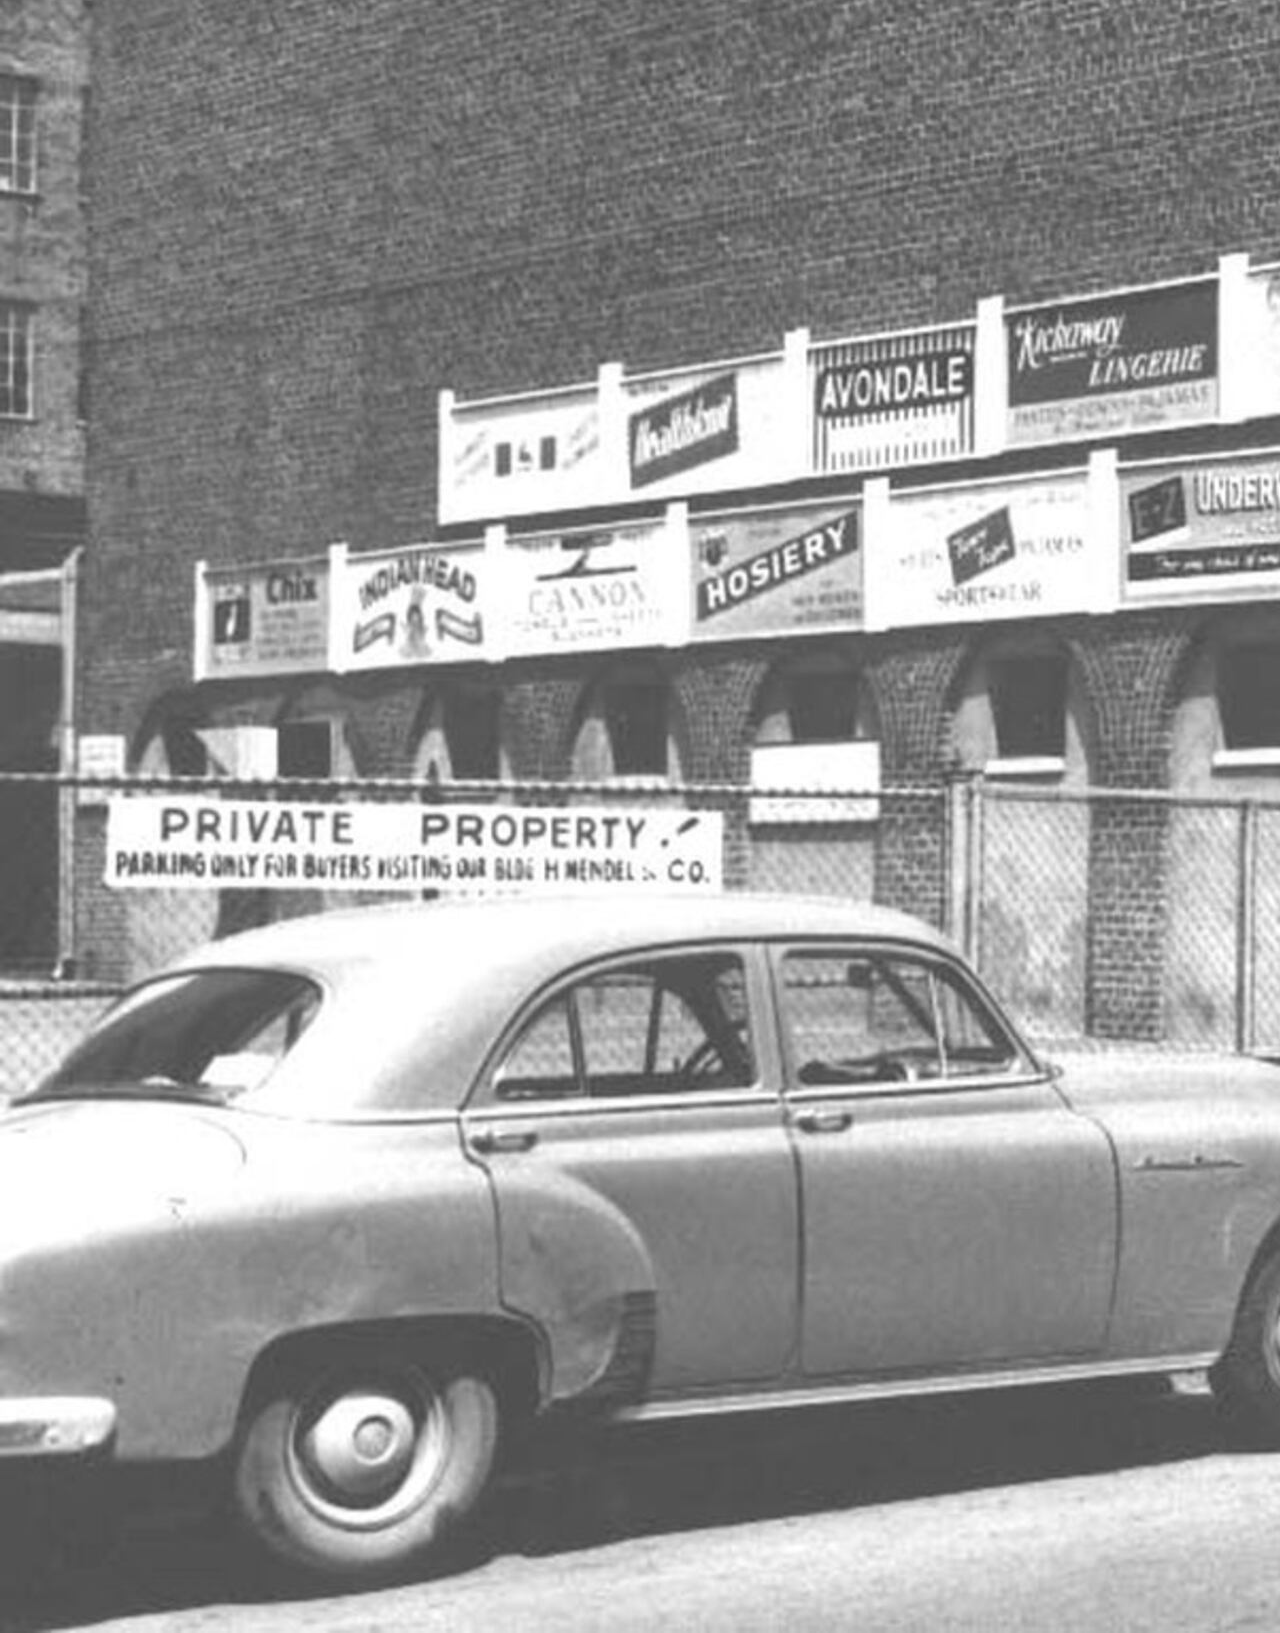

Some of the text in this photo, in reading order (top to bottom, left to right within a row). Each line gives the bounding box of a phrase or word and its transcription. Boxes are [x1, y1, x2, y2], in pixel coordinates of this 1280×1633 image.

[821, 356, 965, 412] AVONDALE
[1089, 343, 1207, 387] LINGERIE
[359, 552, 477, 610] INDIAN HEAD
[706, 519, 848, 611] HOSIERY
[266, 569, 318, 605] Chix
[529, 580, 645, 616] CANNON
[161, 808, 353, 843] PRIVATE
[116, 851, 205, 877] PARKING
[210, 853, 259, 877] ONLY
[264, 853, 297, 877] FOR
[302, 854, 371, 879] BUYERS
[377, 854, 451, 880] VISITING
[456, 855, 487, 878] OUR
[564, 858, 635, 882] MENDEL
[667, 858, 711, 884] CO.
